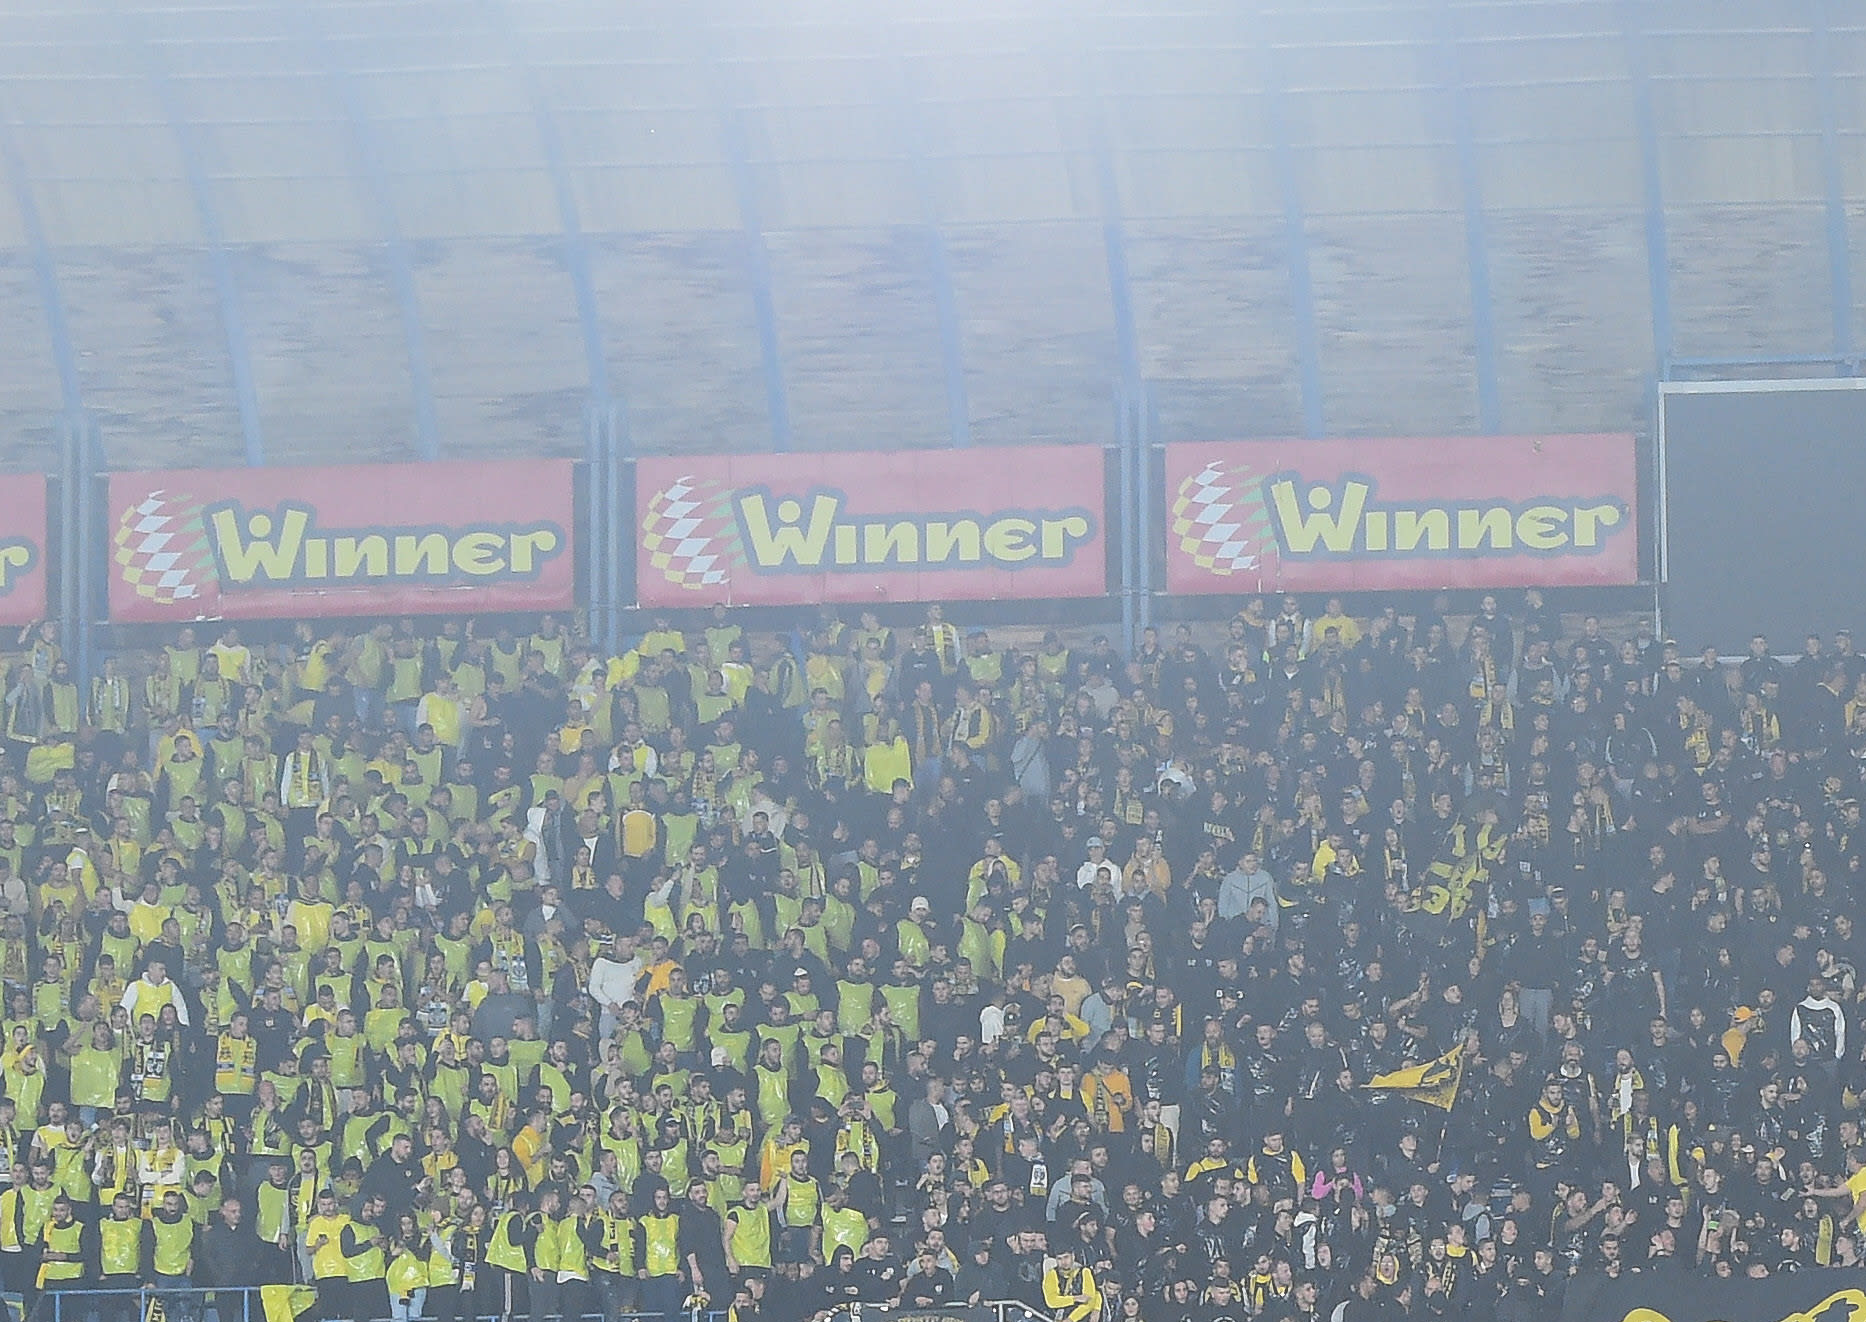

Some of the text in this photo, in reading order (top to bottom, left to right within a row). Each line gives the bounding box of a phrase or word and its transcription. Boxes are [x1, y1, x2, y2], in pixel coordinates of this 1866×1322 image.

[212, 508, 556, 582] Winner
[740, 493, 1087, 566] Winner
[1272, 480, 1620, 555] Winner
